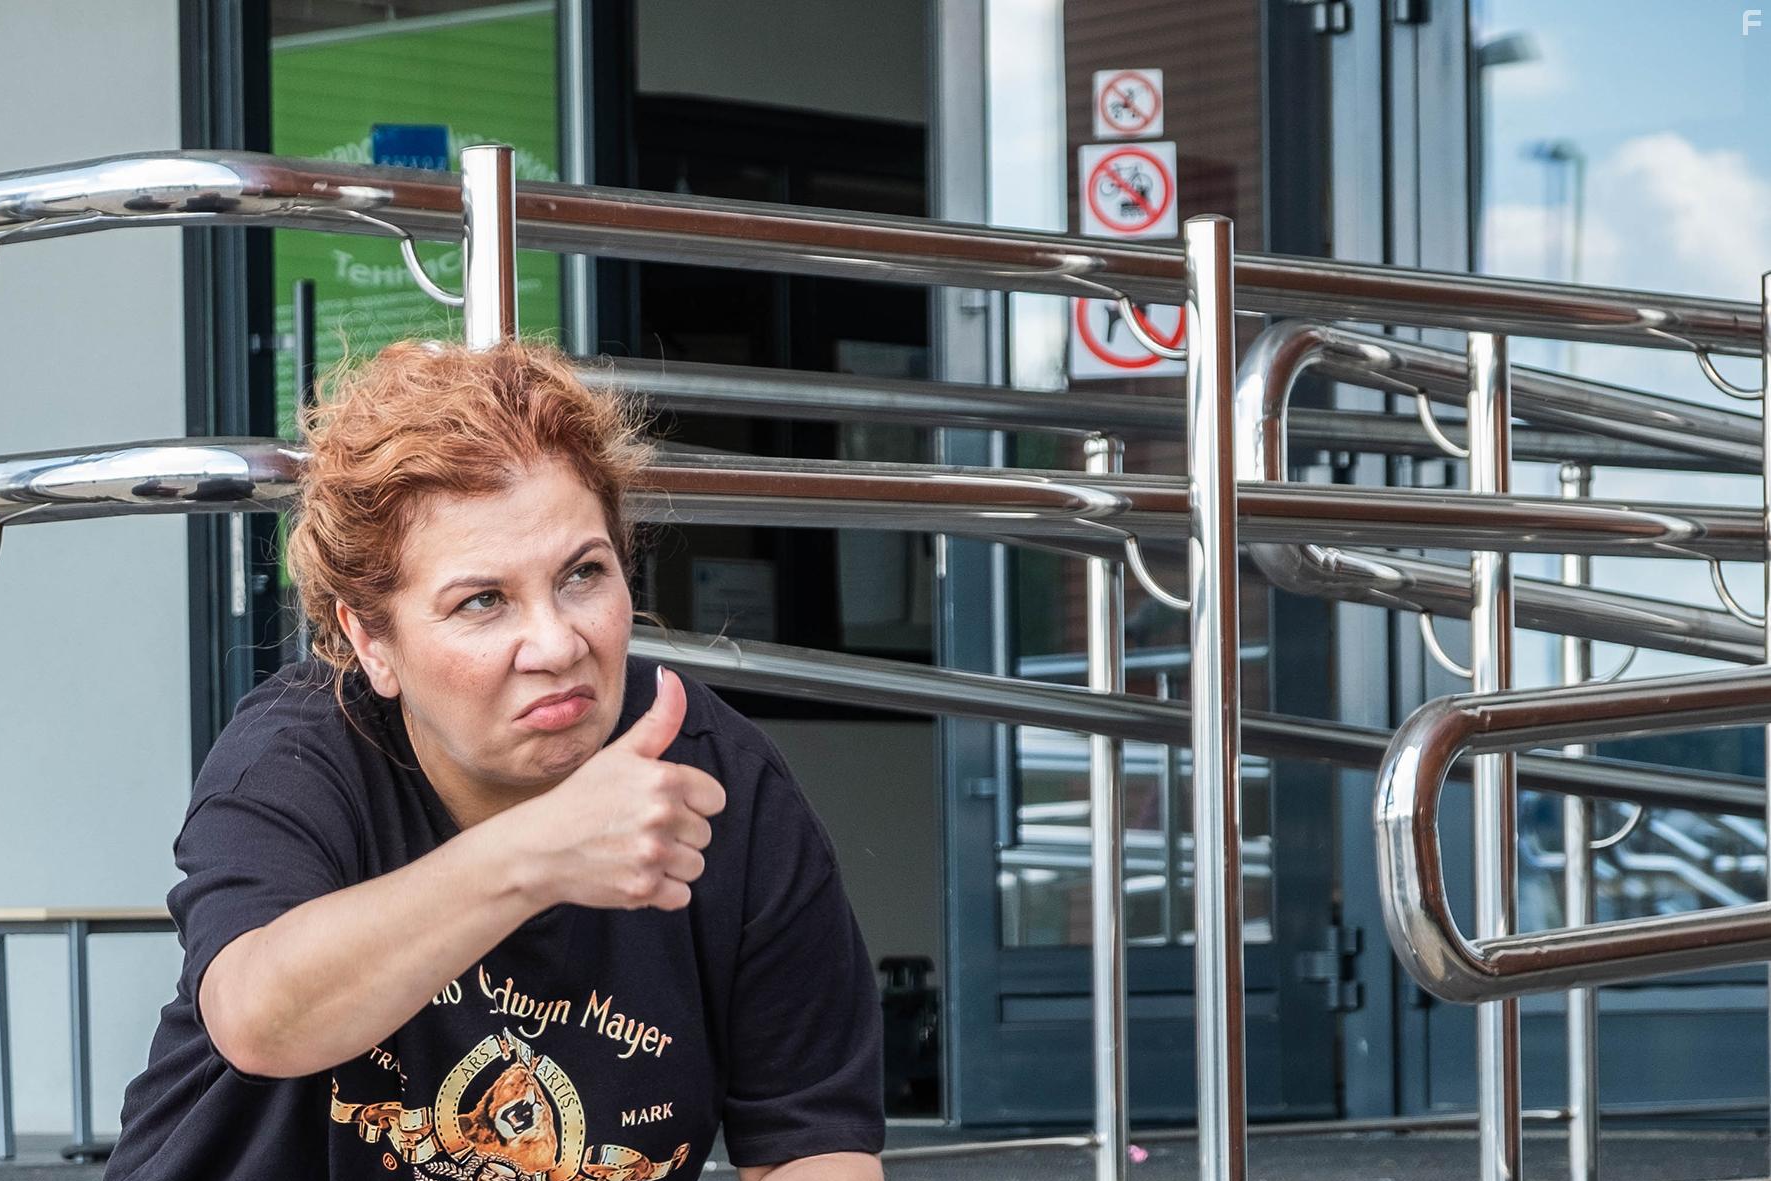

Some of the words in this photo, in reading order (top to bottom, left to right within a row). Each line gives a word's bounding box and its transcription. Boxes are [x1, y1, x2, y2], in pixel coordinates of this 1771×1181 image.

[579, 989, 674, 1059] Mayer
[460, 1047, 493, 1081] ARS
[537, 1064, 577, 1109] ARTIS
[621, 1102, 674, 1128] MARK
